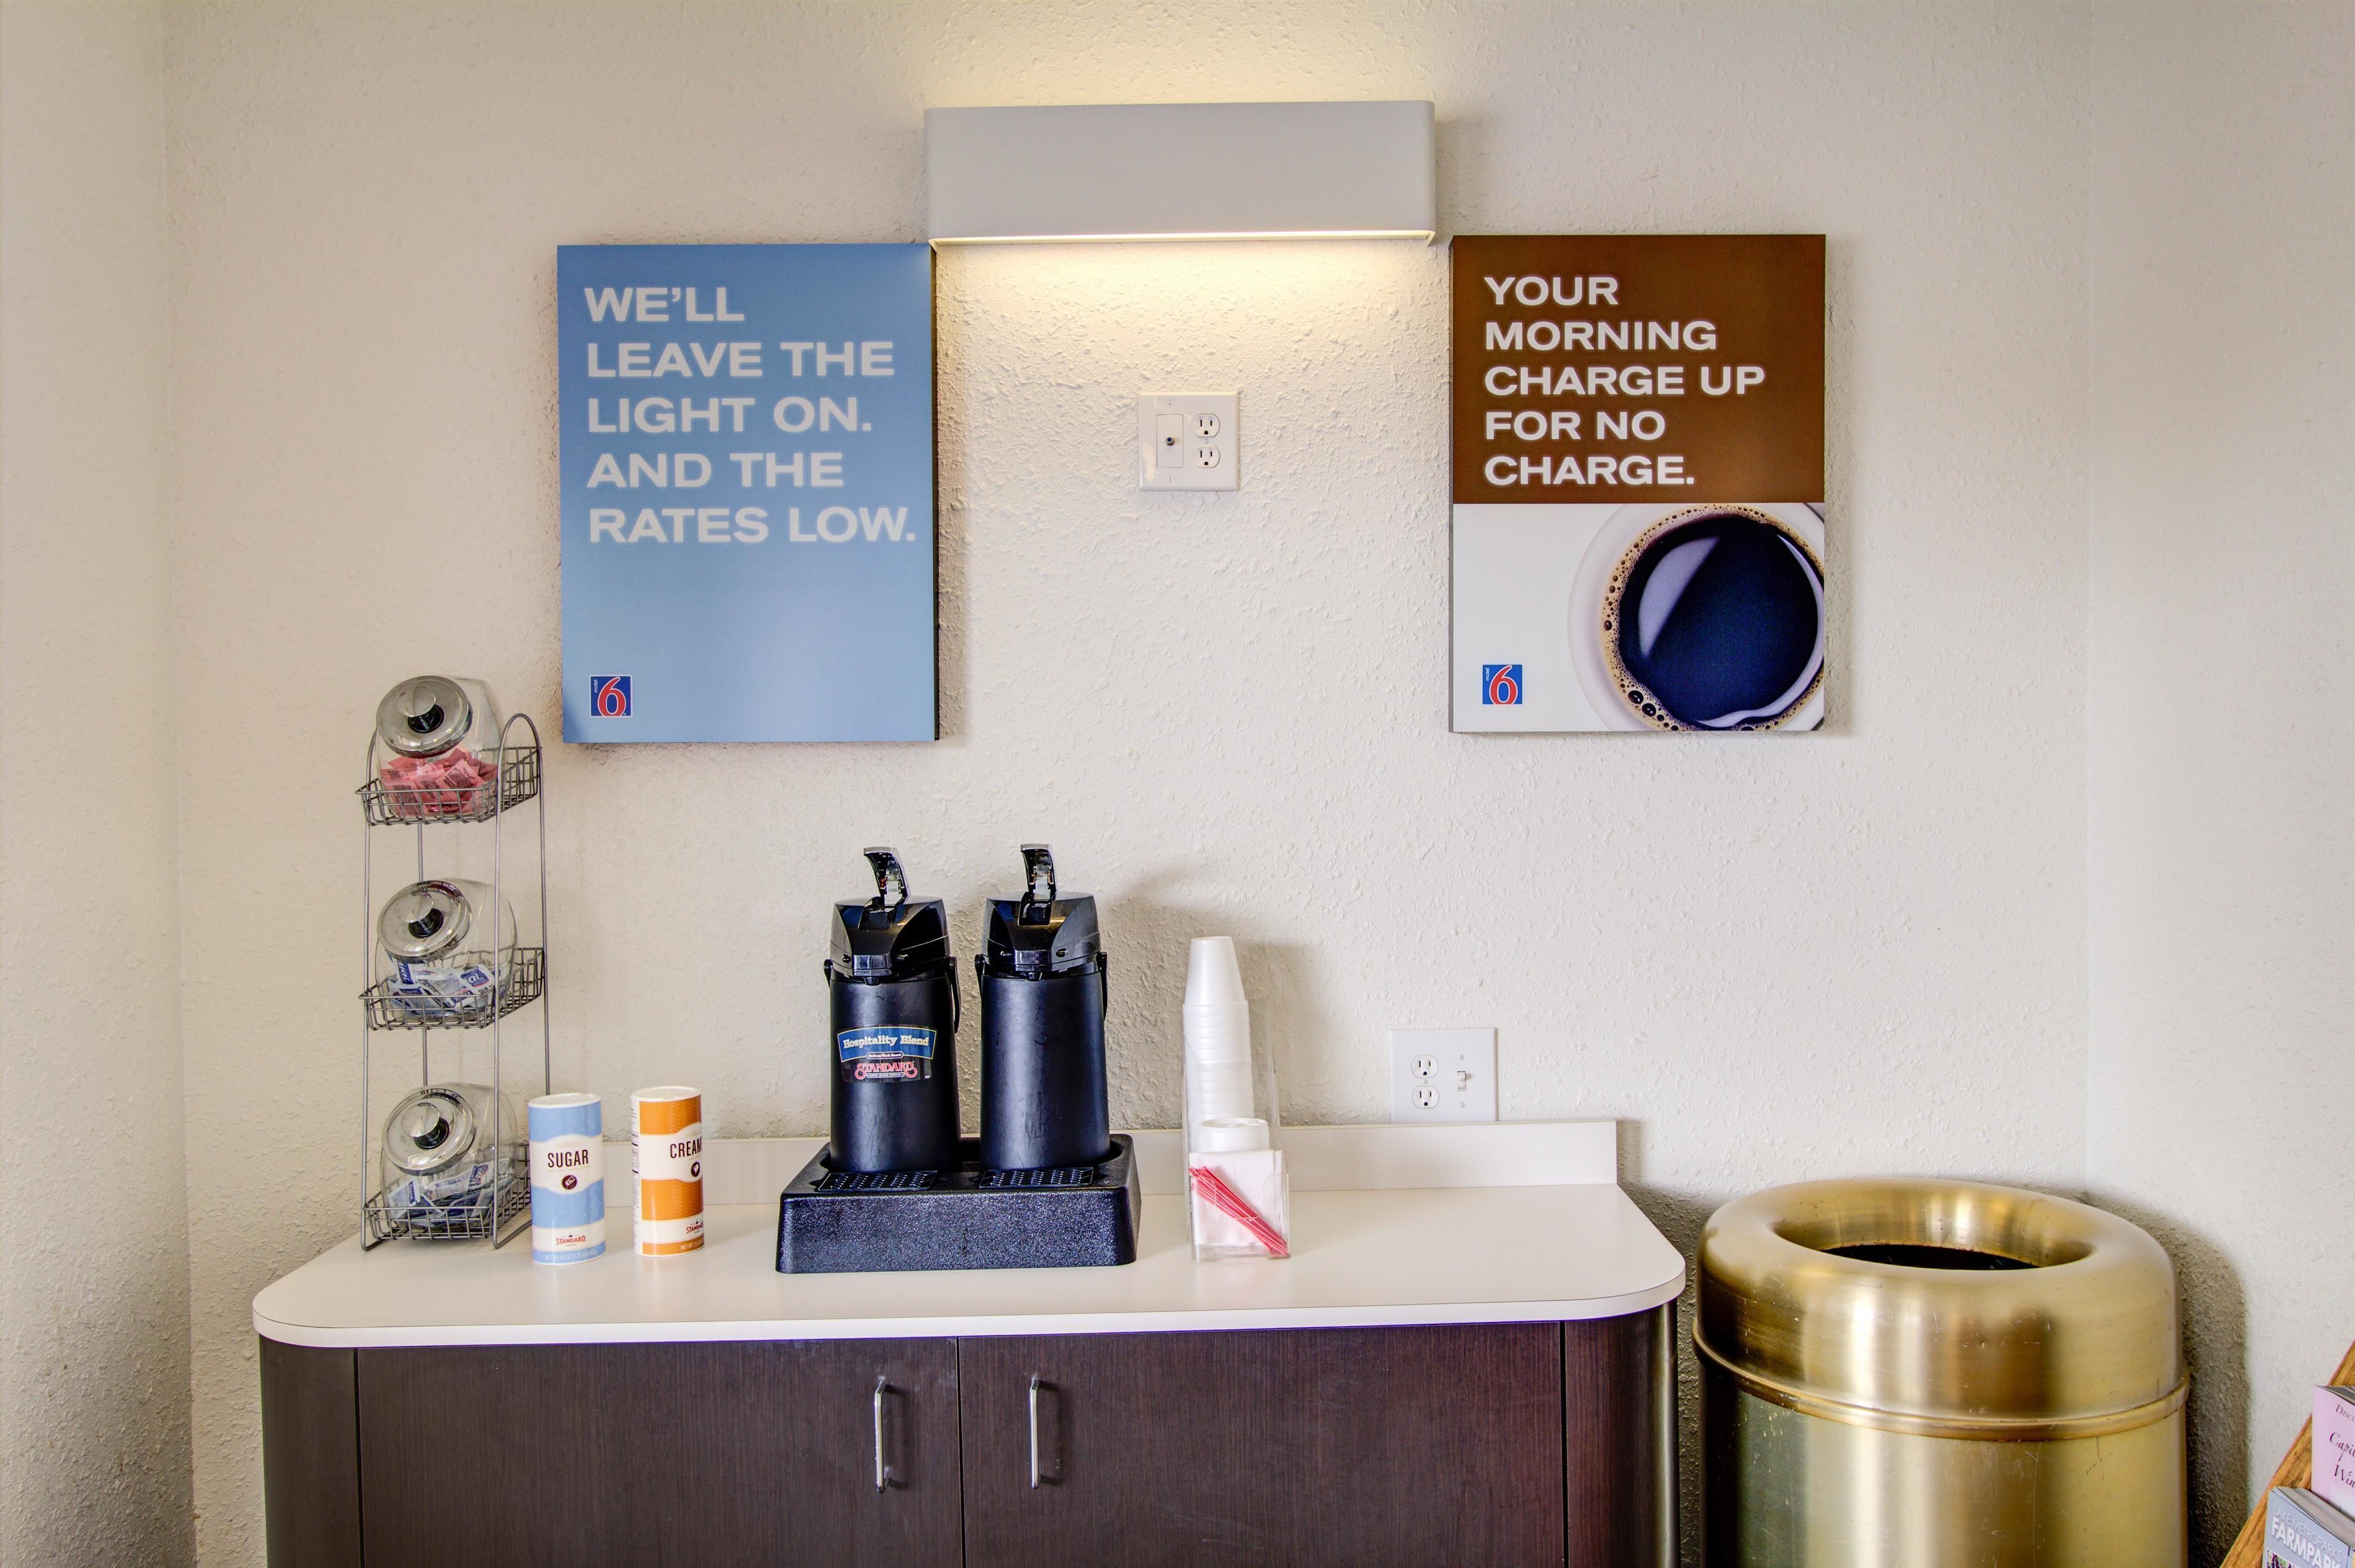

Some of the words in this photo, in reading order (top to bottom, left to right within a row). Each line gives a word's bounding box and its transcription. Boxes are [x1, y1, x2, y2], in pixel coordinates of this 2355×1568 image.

[584, 287, 745, 322] WE'LL
[1484, 276, 1618, 305] YOUR
[1485, 321, 1717, 351] MORNING
[588, 343, 763, 378] LEAVE
[780, 342, 895, 376] THE
[1484, 366, 1685, 396] CHARGE
[1700, 366, 1765, 395] UP
[588, 397, 756, 432] LIGHT
[773, 396, 872, 432] ON.
[1485, 411, 1581, 440] FOR
[1596, 411, 1666, 440] NO
[586, 453, 713, 488] AND
[730, 453, 844, 487] THE
[1484, 456, 1694, 485] CHARGE.
[589, 508, 769, 543] RATES
[789, 507, 916, 541] LOW.
[597, 676, 626, 717] 6
[1488, 664, 1518, 705] 6
[843, 1035, 897, 1048] Hospitality
[900, 1035, 929, 1046] Blend
[855, 1061, 917, 1079] STANDARD
[548, 1149, 589, 1168] SUGAR
[556, 1235, 586, 1245] STANDARD
[2271, 1516, 2342, 1568] FARMPAR
[2273, 1503, 2292, 1525] LAKE
[2292, 1520, 2343, 1562] METROPARKS
